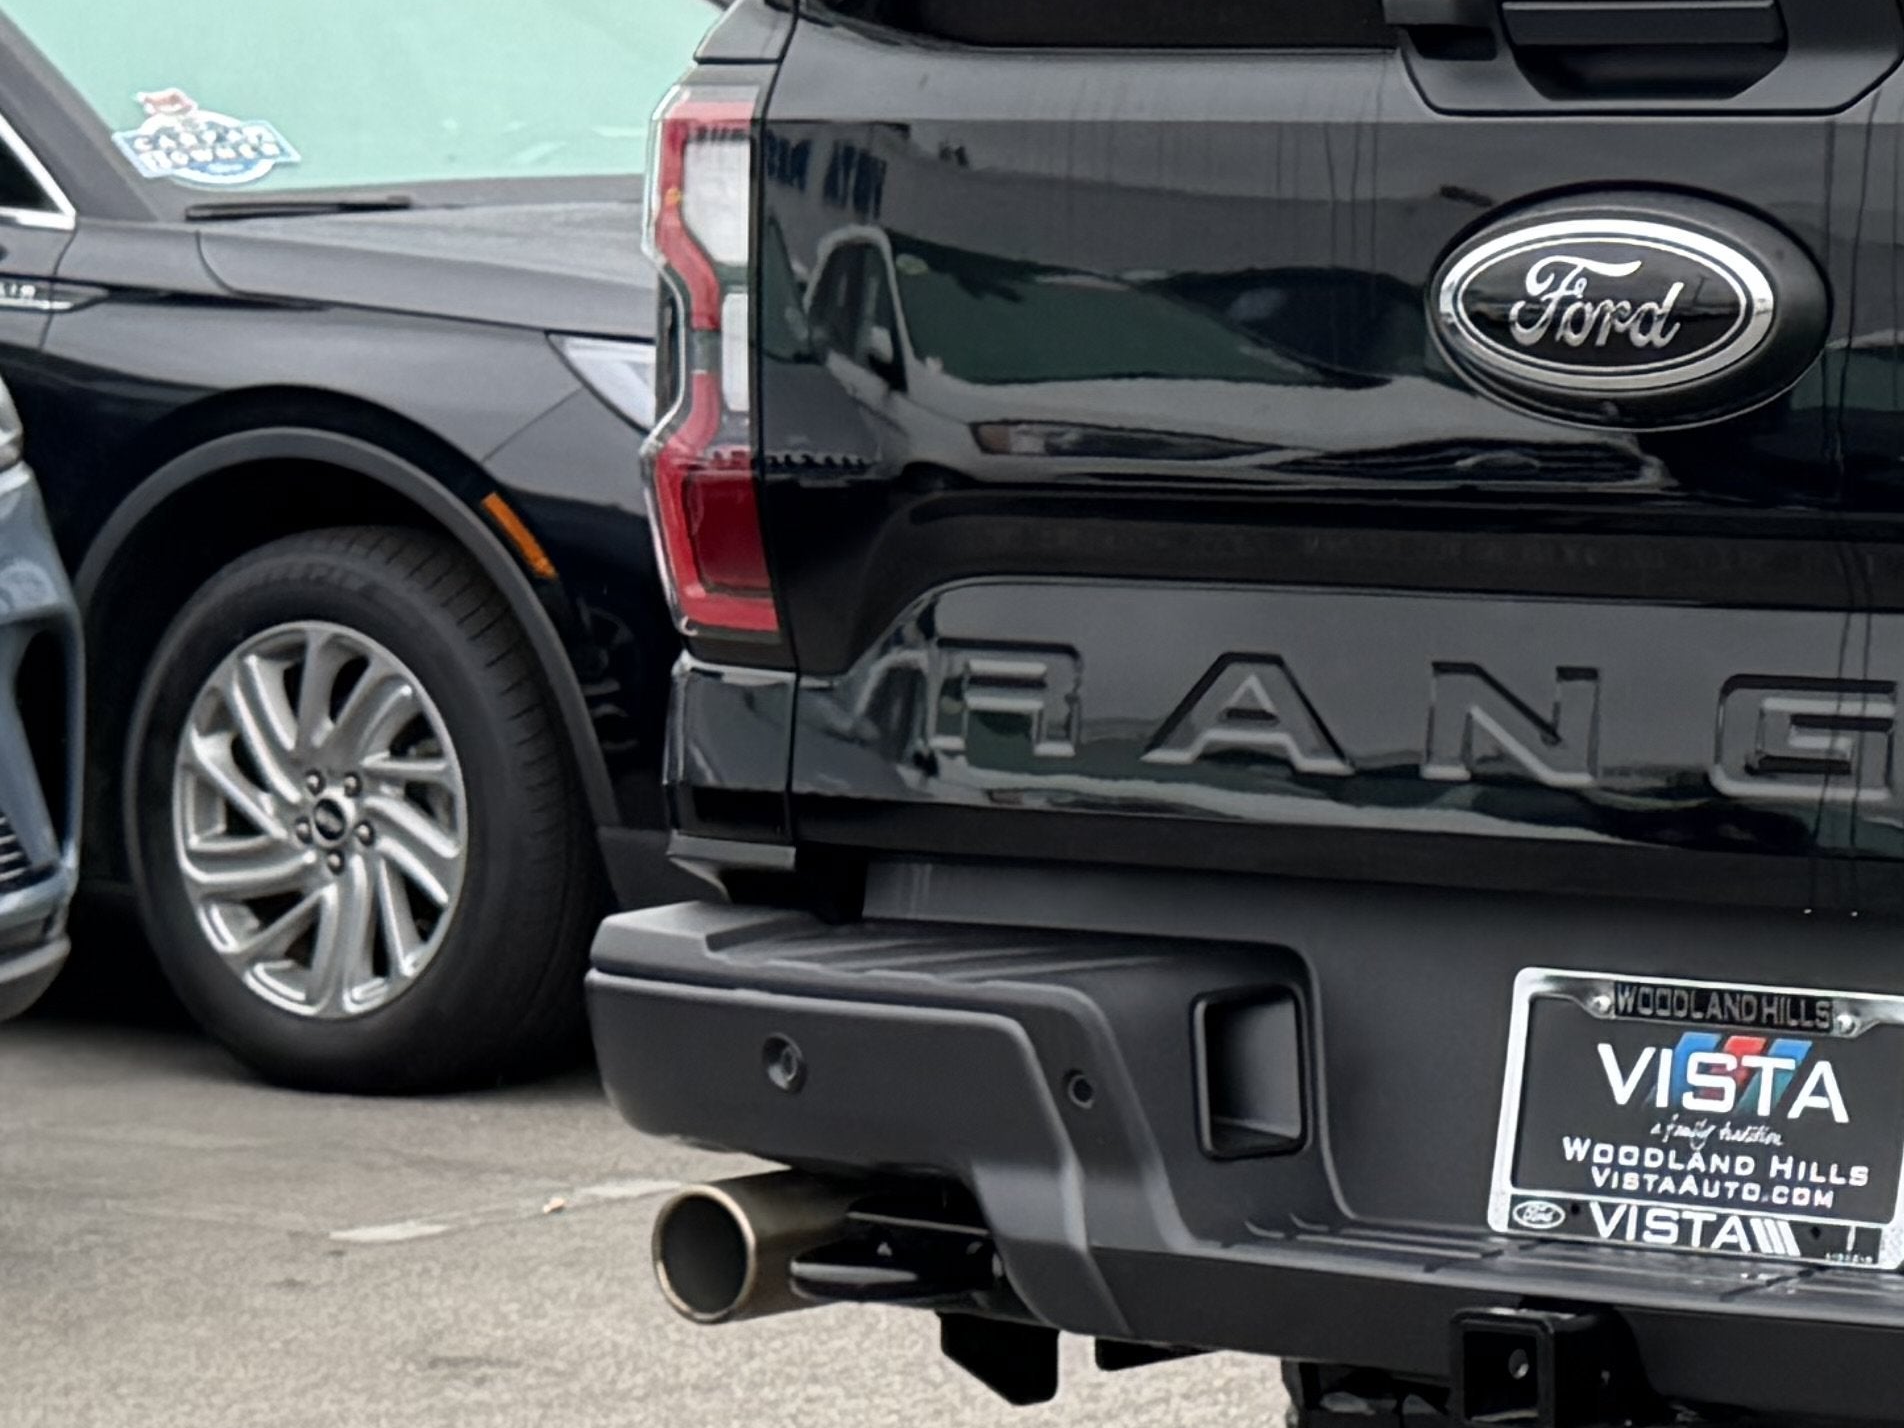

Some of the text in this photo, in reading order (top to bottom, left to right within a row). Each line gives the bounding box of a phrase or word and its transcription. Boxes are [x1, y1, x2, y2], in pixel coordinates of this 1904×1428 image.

[1509, 254, 1685, 349] Ford
[1616, 983, 1832, 1030] WOODLAND HILLS
[1597, 1042, 1850, 1124] VISTA
[1562, 1136, 1870, 1188] WOODLAND HILLS
[1590, 1166, 1836, 1211] VISTAAUTO.COM
[1589, 1200, 1753, 1255] VISTA
